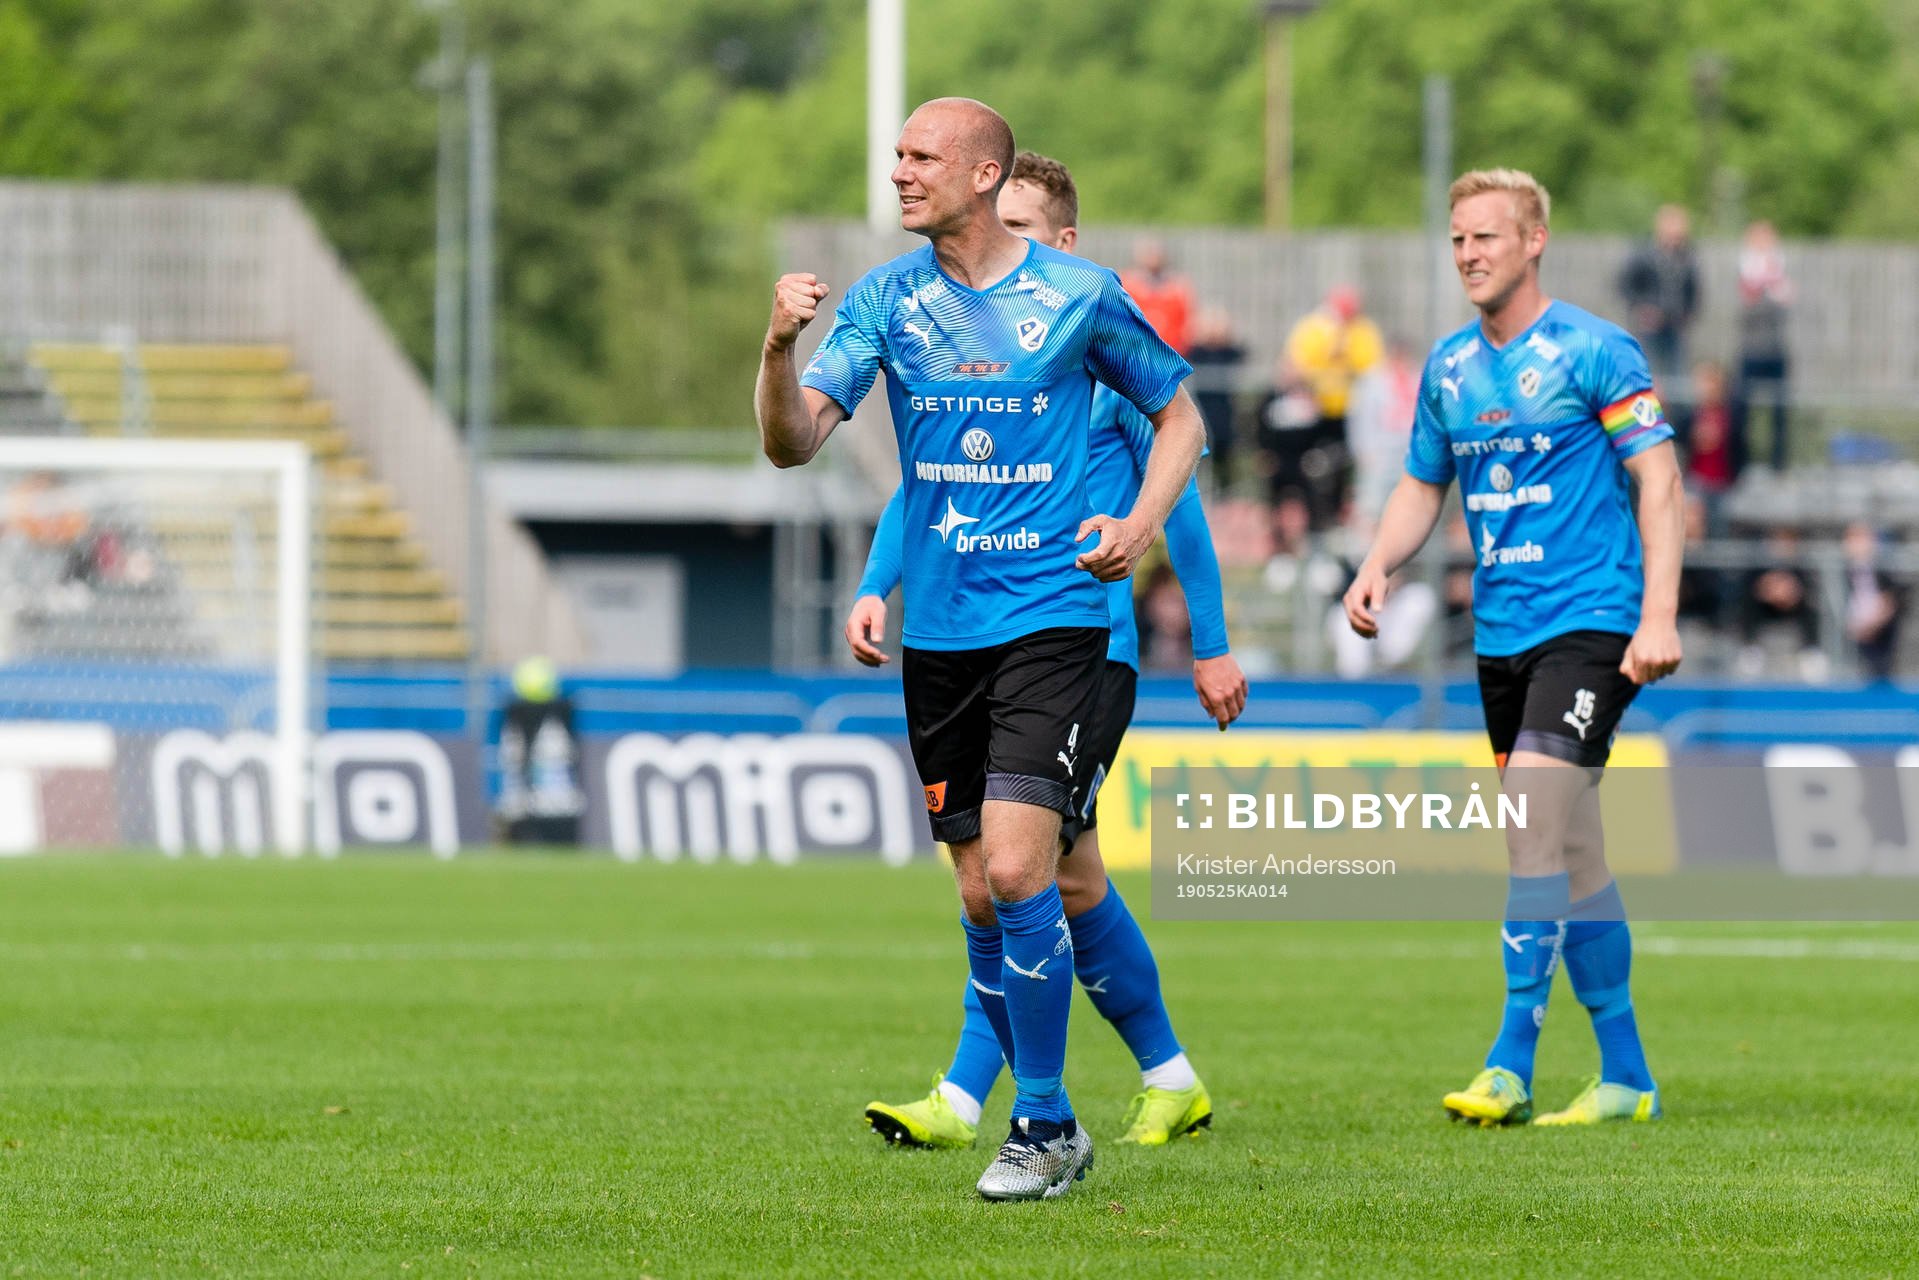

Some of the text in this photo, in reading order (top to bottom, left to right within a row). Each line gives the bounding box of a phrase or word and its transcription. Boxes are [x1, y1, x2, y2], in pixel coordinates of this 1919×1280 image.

[911, 396, 1022, 413] GETINGE
[1451, 437, 1526, 457] GETINGE
[915, 461, 1053, 484] MOTORHALLAND
[956, 527, 1040, 553] bravida
[1573, 688, 1596, 720] 15
[1068, 723, 1080, 754] 4
